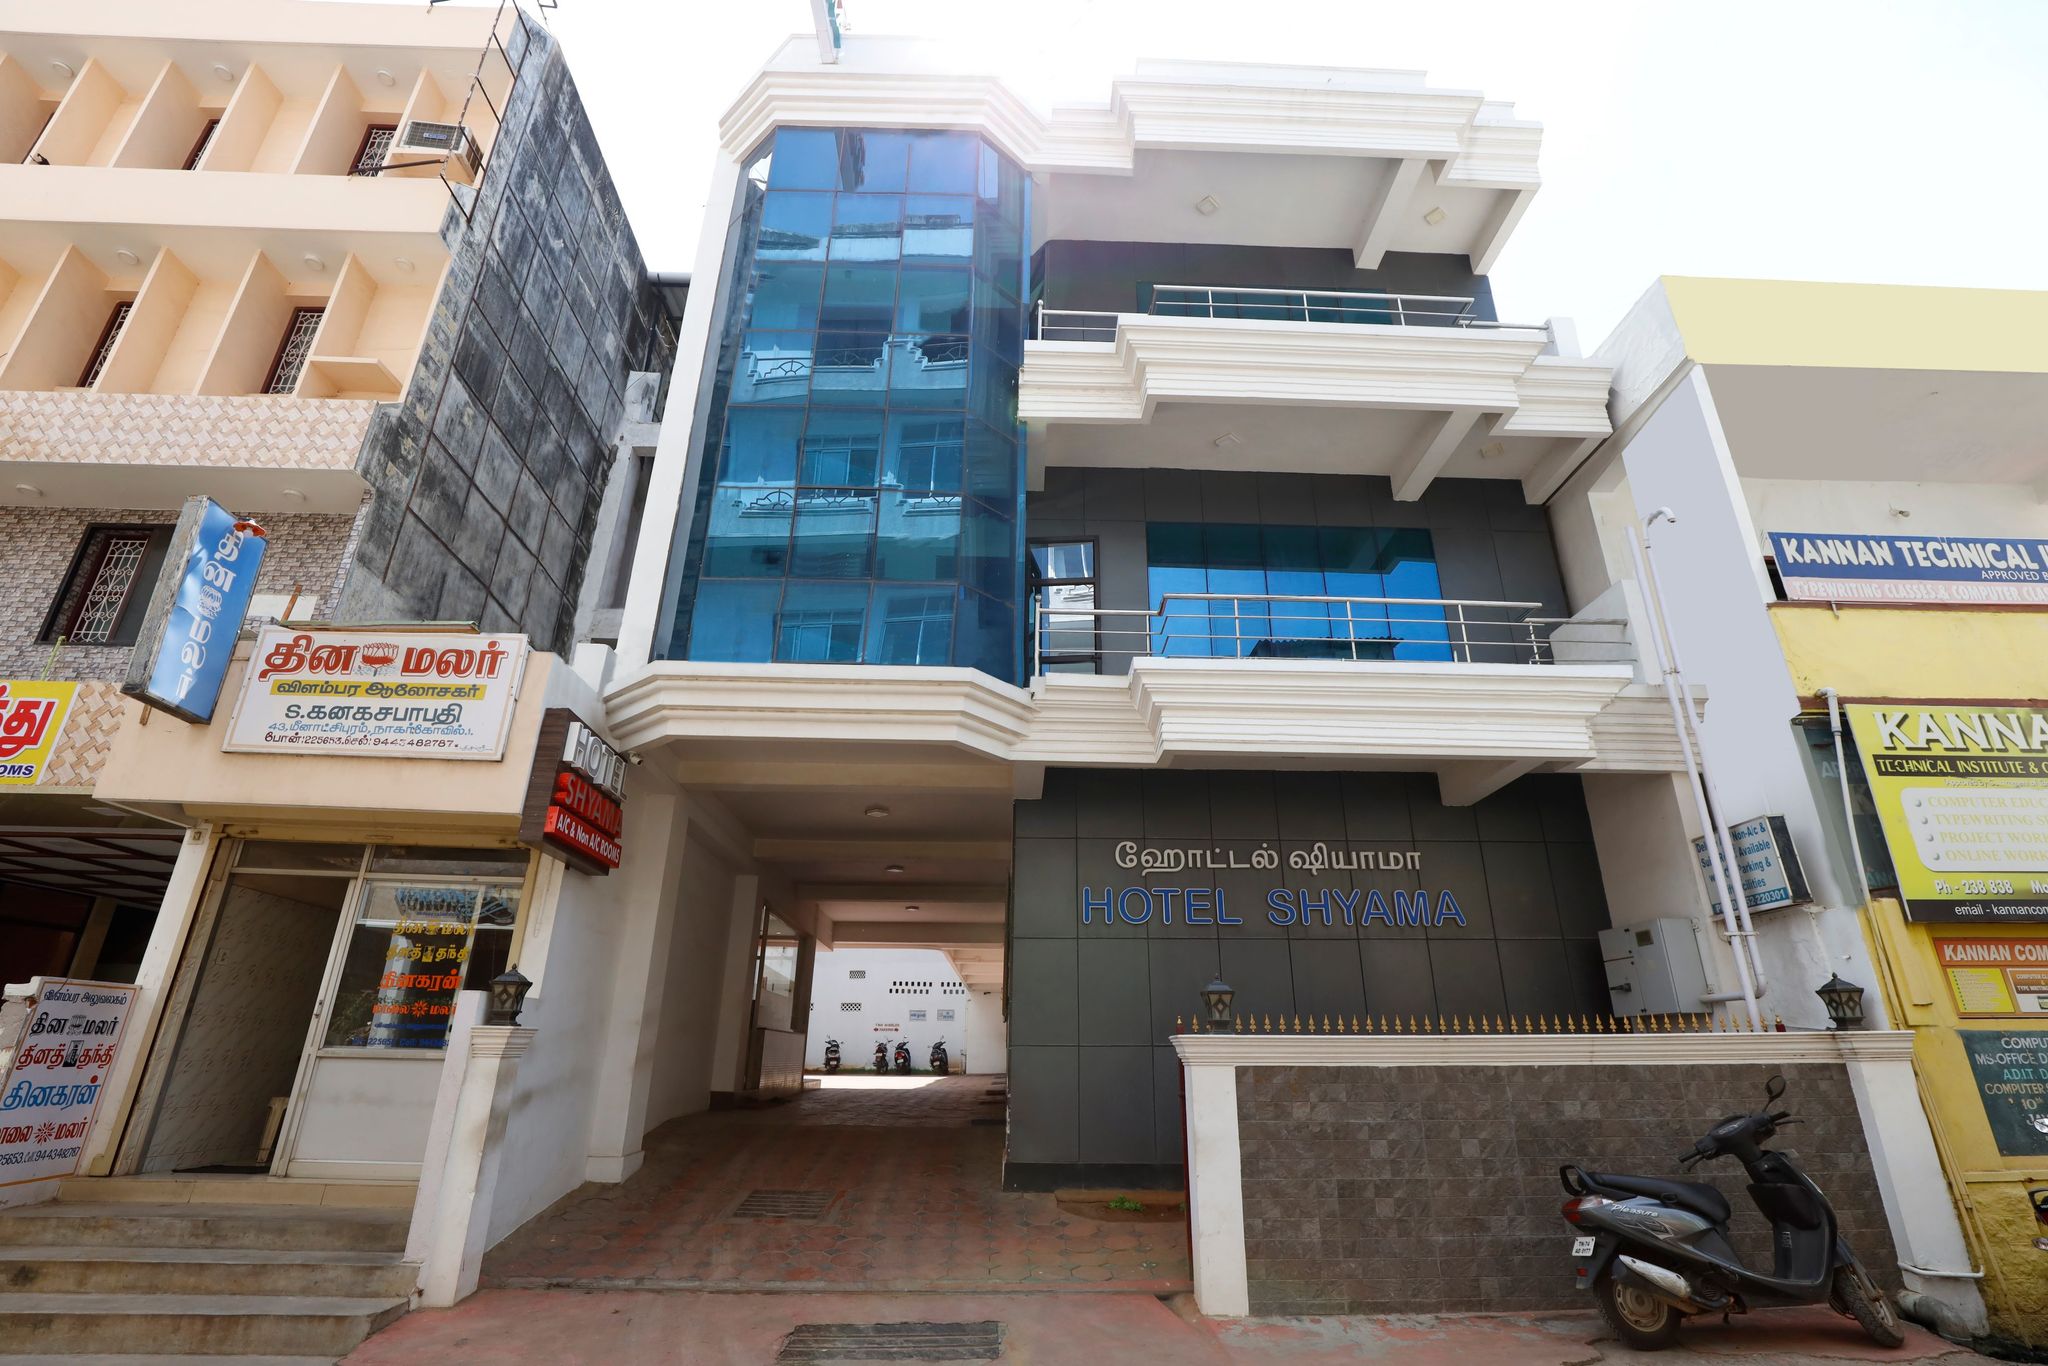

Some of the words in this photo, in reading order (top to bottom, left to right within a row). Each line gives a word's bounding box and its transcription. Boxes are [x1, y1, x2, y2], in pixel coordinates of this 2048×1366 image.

[1780, 537, 1896, 567] KANNAN
[1894, 540, 2040, 570] TECHNICAL
[2037, 544, 2048, 569] I
[1981, 570, 2040, 581] APPROVED
[1792, 579, 1883, 599] TYPEWRITING
[1951, 584, 2022, 602] COMPUTER
[257, 634, 361, 683] தின
[400, 640, 510, 680] மலர்
[276, 680, 362, 698] விளம்பர
[365, 681, 481, 699] ஆலோசகர்
[1873, 711, 2048, 752] KANNA
[564, 721, 628, 800] HOTEL
[1876, 758, 1956, 773] TECHNICAL
[1956, 760, 2026, 774] INSTITUTE
[2029, 761, 2039, 774] &
[562, 772, 623, 840] SHYAMA
[1927, 797, 2008, 808] COMPUTER
[1933, 814, 2034, 825] TYPEWRITING
[557, 814, 571, 834] A/C
[569, 822, 576, 838] &
[576, 825, 589, 846] Non
[588, 833, 601, 852] A/C
[600, 840, 620, 863] ROOMS
[1731, 826, 1758, 841] Non-A/c
[1759, 822, 1767, 833] &
[1940, 832, 2004, 843] PROJECT
[1738, 840, 1771, 857] Available
[1945, 849, 2000, 861] ONLINE
[1114, 841, 1280, 876] ஹோட்டல்
[1289, 842, 1421, 875] ஷியாமா
[1764, 856, 1772, 867] &
[1742, 877, 1767, 891] cilities
[1934, 880, 1953, 895] Ph
[1961, 880, 1988, 895] 238
[1988, 880, 2015, 895] 838
[1081, 886, 1243, 926] HOTEL
[1266, 887, 1467, 927] SHYAMA
[1954, 903, 1984, 915] email
[1943, 944, 2012, 961] KANNAN
[2014, 944, 2048, 961] COM
[29, 1011, 69, 1037] தின
[82, 1016, 119, 1037] மலர்
[2001, 1037, 2048, 1049] COMPU
[1974, 1052, 2038, 1065] MS-OFFICE
[2038, 1052, 2048, 1065] D
[0, 1075, 101, 1111] தினகரன்
[1984, 1083, 2046, 1095] COMPUTER
[0, 1125, 34, 1144] ாலை
[54, 1116, 88, 1140] மலர்
[1611, 1203, 1659, 1217] Pleasure
